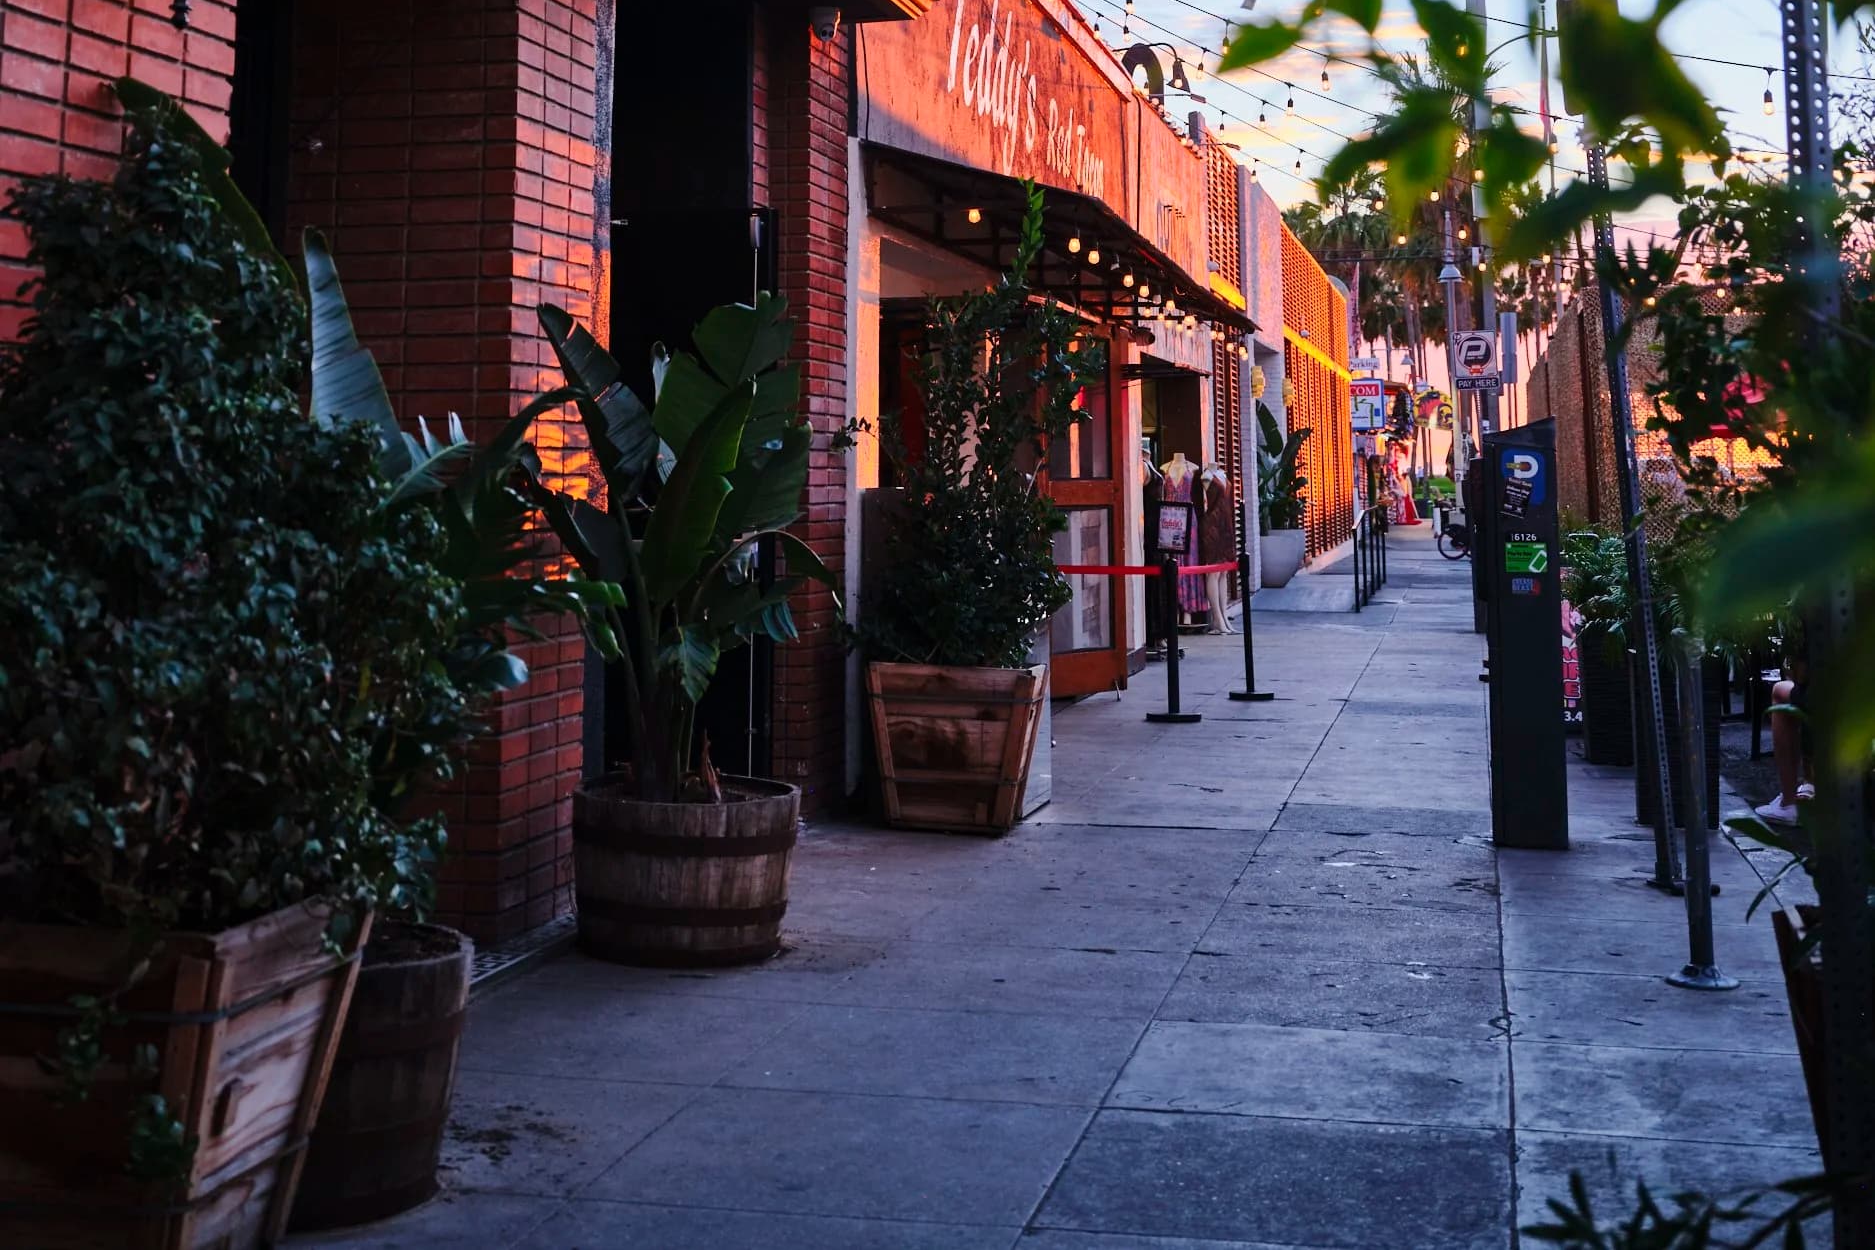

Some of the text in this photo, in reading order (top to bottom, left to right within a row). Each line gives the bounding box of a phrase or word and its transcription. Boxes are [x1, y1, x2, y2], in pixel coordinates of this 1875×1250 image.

[1046, 97, 1074, 179] Red
[1458, 378, 1497, 388] PAY HERE
